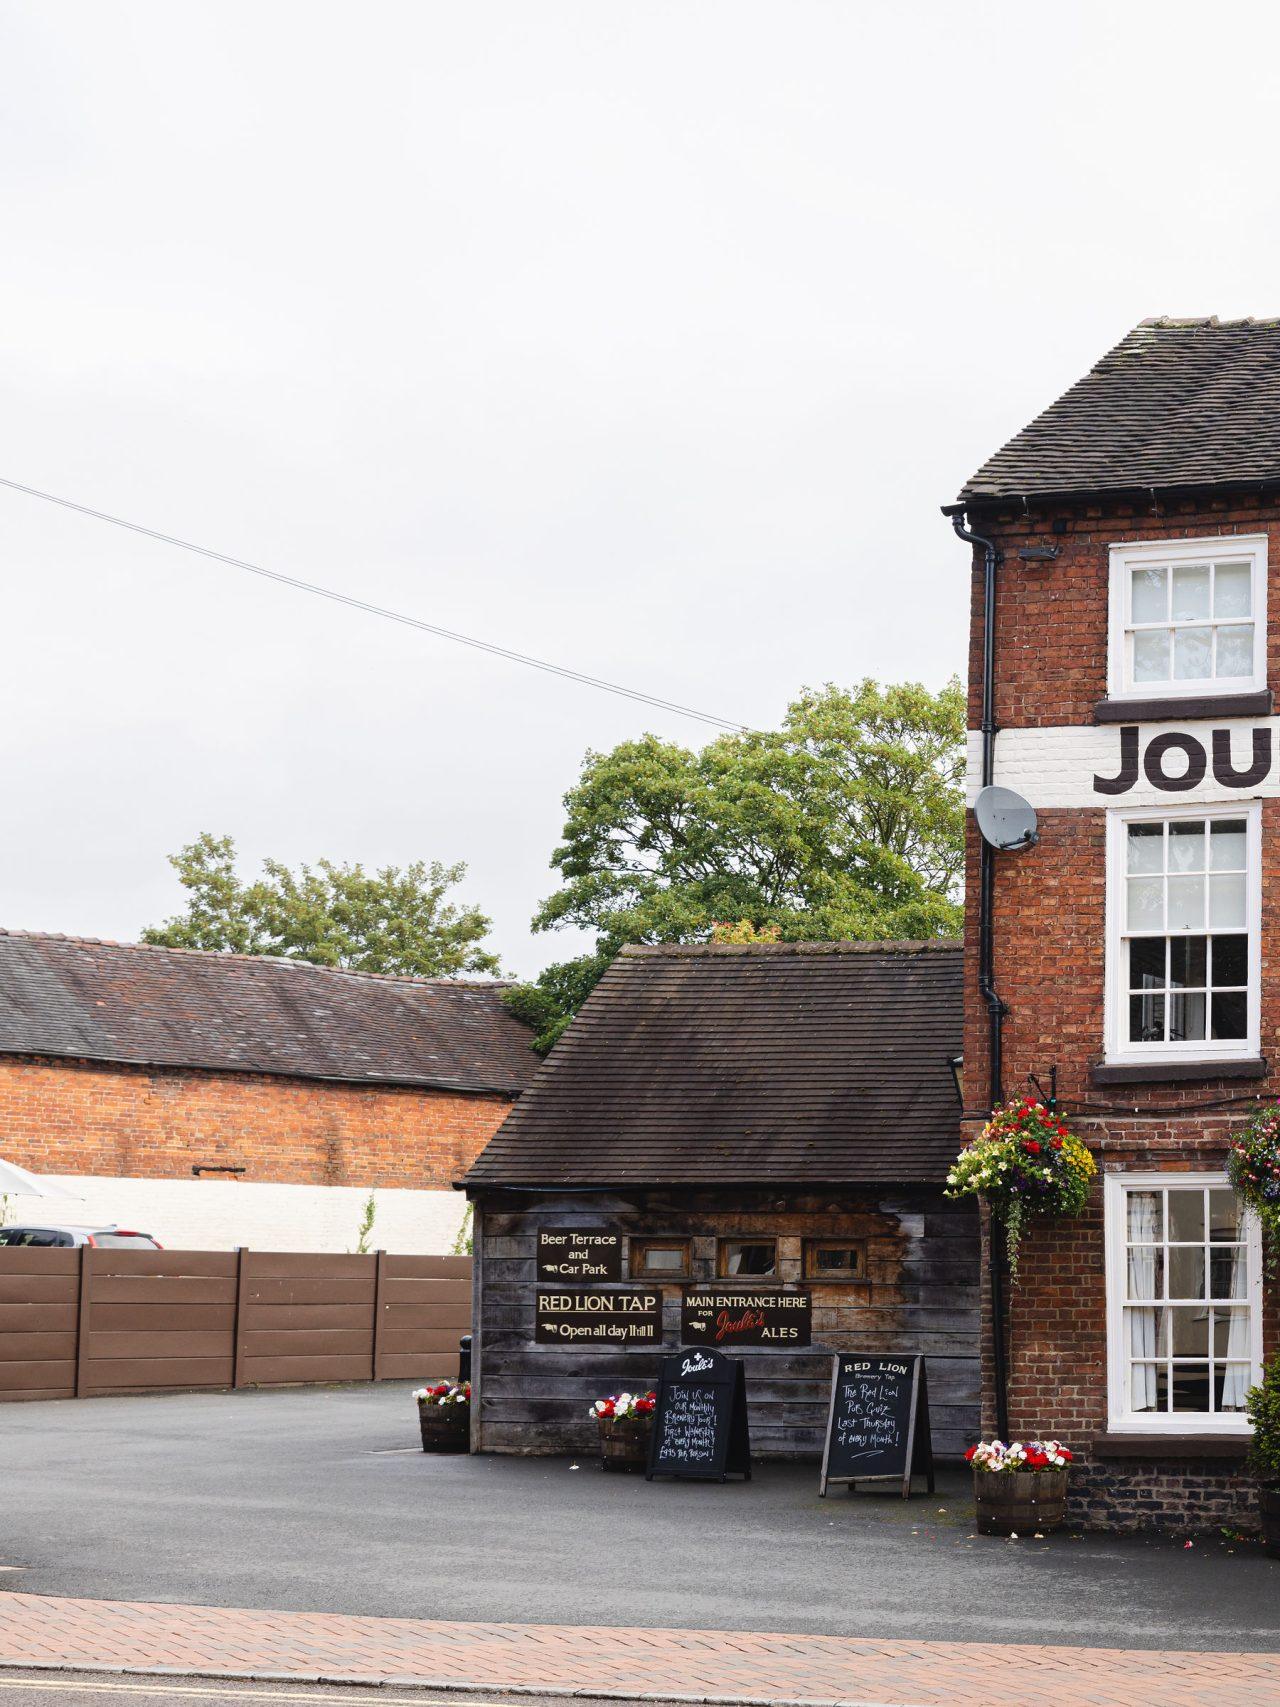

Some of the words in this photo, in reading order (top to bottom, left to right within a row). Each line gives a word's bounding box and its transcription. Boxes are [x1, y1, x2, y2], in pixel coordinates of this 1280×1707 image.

[541, 1233, 568, 1245] Beer
[569, 1233, 617, 1245] Terrace
[568, 1249, 588, 1260] and
[559, 1263, 579, 1274] Car
[582, 1263, 608, 1275] Park
[539, 1295, 572, 1311] RED
[575, 1295, 614, 1311] LION
[618, 1296, 656, 1311] TAP
[686, 1296, 714, 1307] MAIN
[716, 1296, 776, 1307] ENTRANCE
[778, 1297, 807, 1308] HERE
[559, 1324, 592, 1340] Open
[593, 1324, 606, 1337] all
[607, 1324, 628, 1341] day
[761, 1327, 798, 1338] ALES
[844, 1362, 871, 1373] RED
[879, 1362, 908, 1375] LION
[855, 1373, 881, 1381] Brewery
[885, 1373, 896, 1381] Tap
[842, 1384, 857, 1398] The
[860, 1383, 877, 1402] Red
[837, 1417, 857, 1430] Last
[838, 1432, 847, 1446] of
